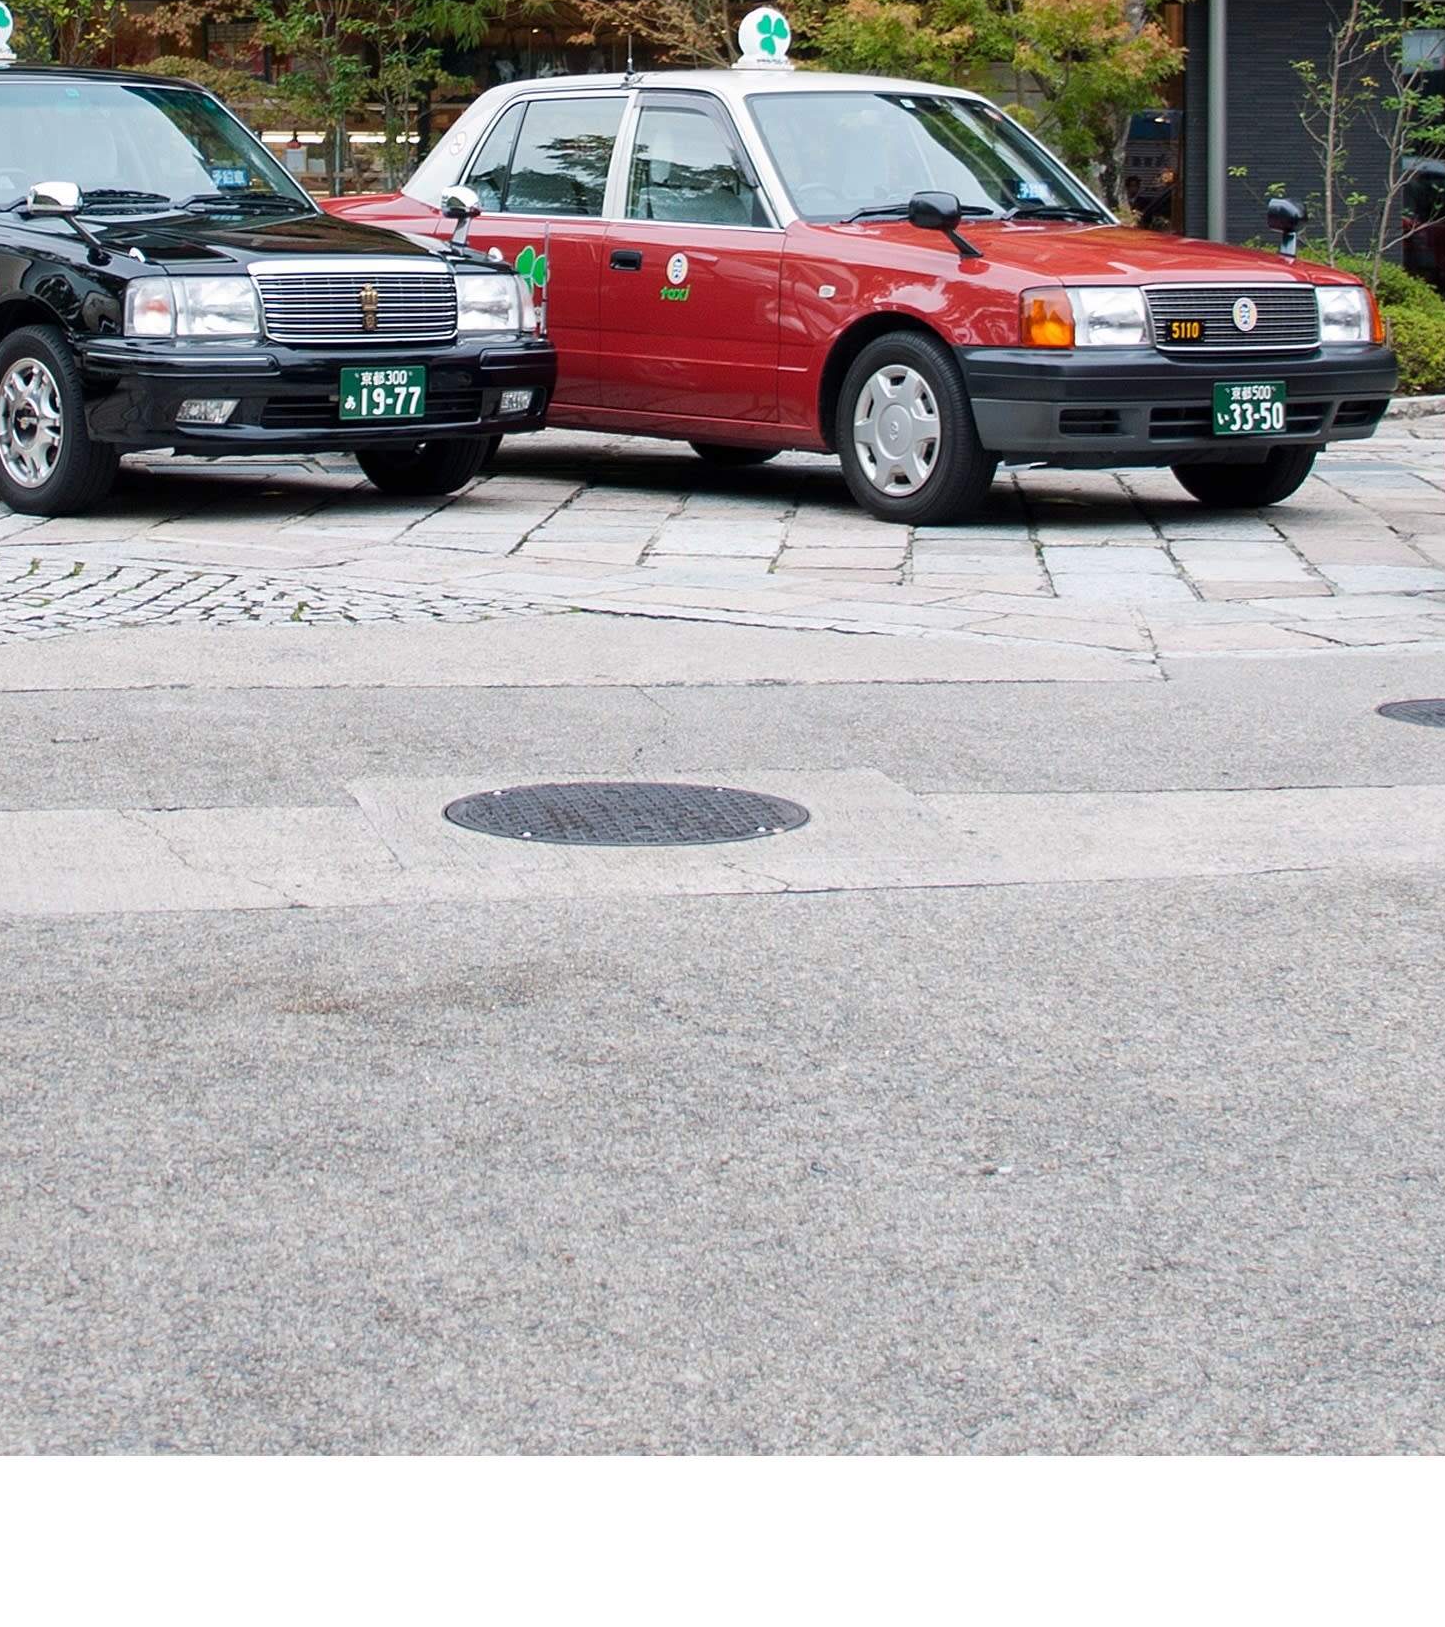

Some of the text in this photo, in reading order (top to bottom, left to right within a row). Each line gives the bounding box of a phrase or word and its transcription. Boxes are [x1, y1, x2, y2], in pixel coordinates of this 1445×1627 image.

[659, 284, 691, 302] taxi
[1171, 322, 1200, 339] 5110
[344, 386, 422, 416] あ 19-77
[1229, 401, 1284, 431] 33-50
